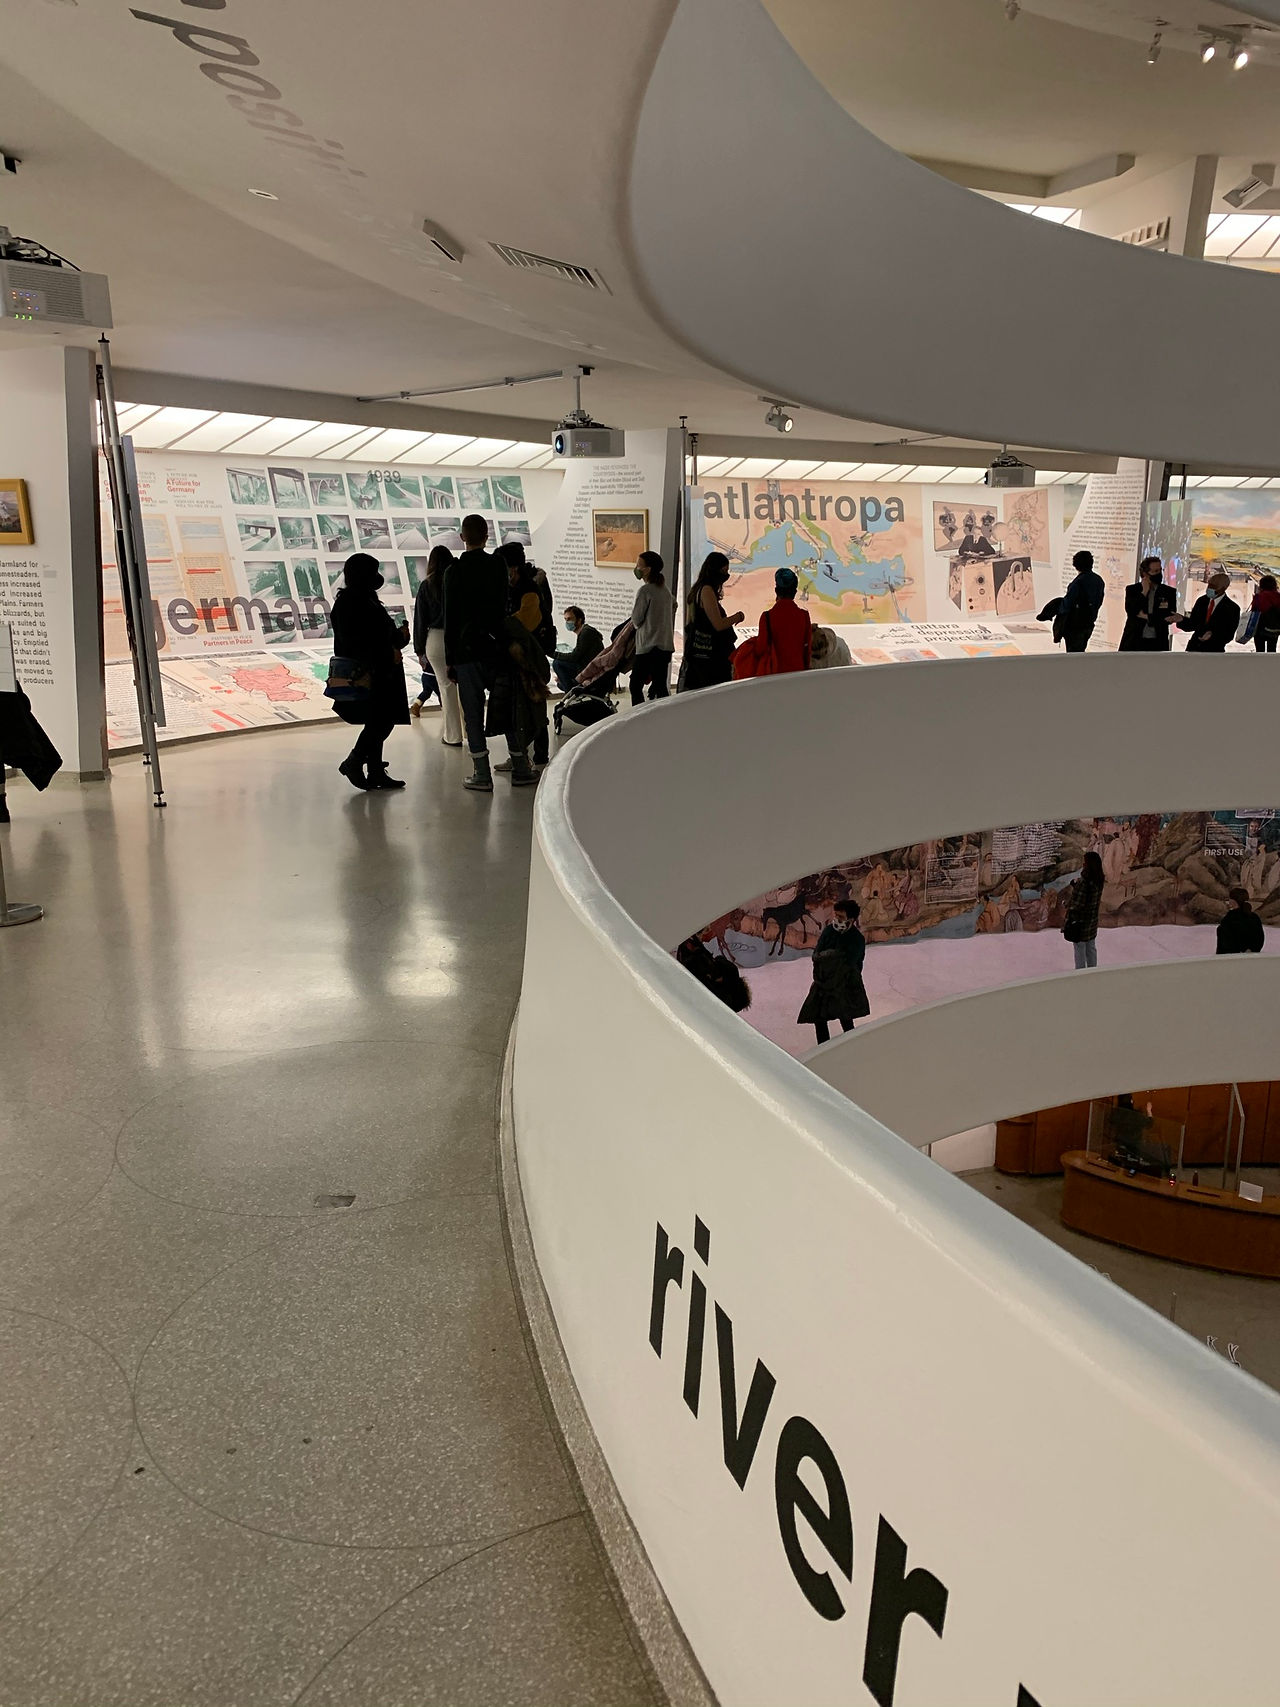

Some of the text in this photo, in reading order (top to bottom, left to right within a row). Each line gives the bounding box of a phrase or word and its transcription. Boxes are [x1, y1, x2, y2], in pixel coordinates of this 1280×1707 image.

[367, 470, 401, 483] 1939
[167, 486, 196, 494] Germany
[703, 482, 905, 531] atlantropa
[10, 580, 41, 588] increased
[10, 590, 42, 598] increased
[19, 600, 44, 608] Farmers
[37, 630, 48, 638] big
[24, 639, 49, 647] Emptied
[1204, 848, 1227, 857] FIRST
[649, 1214, 949, 1707] river
